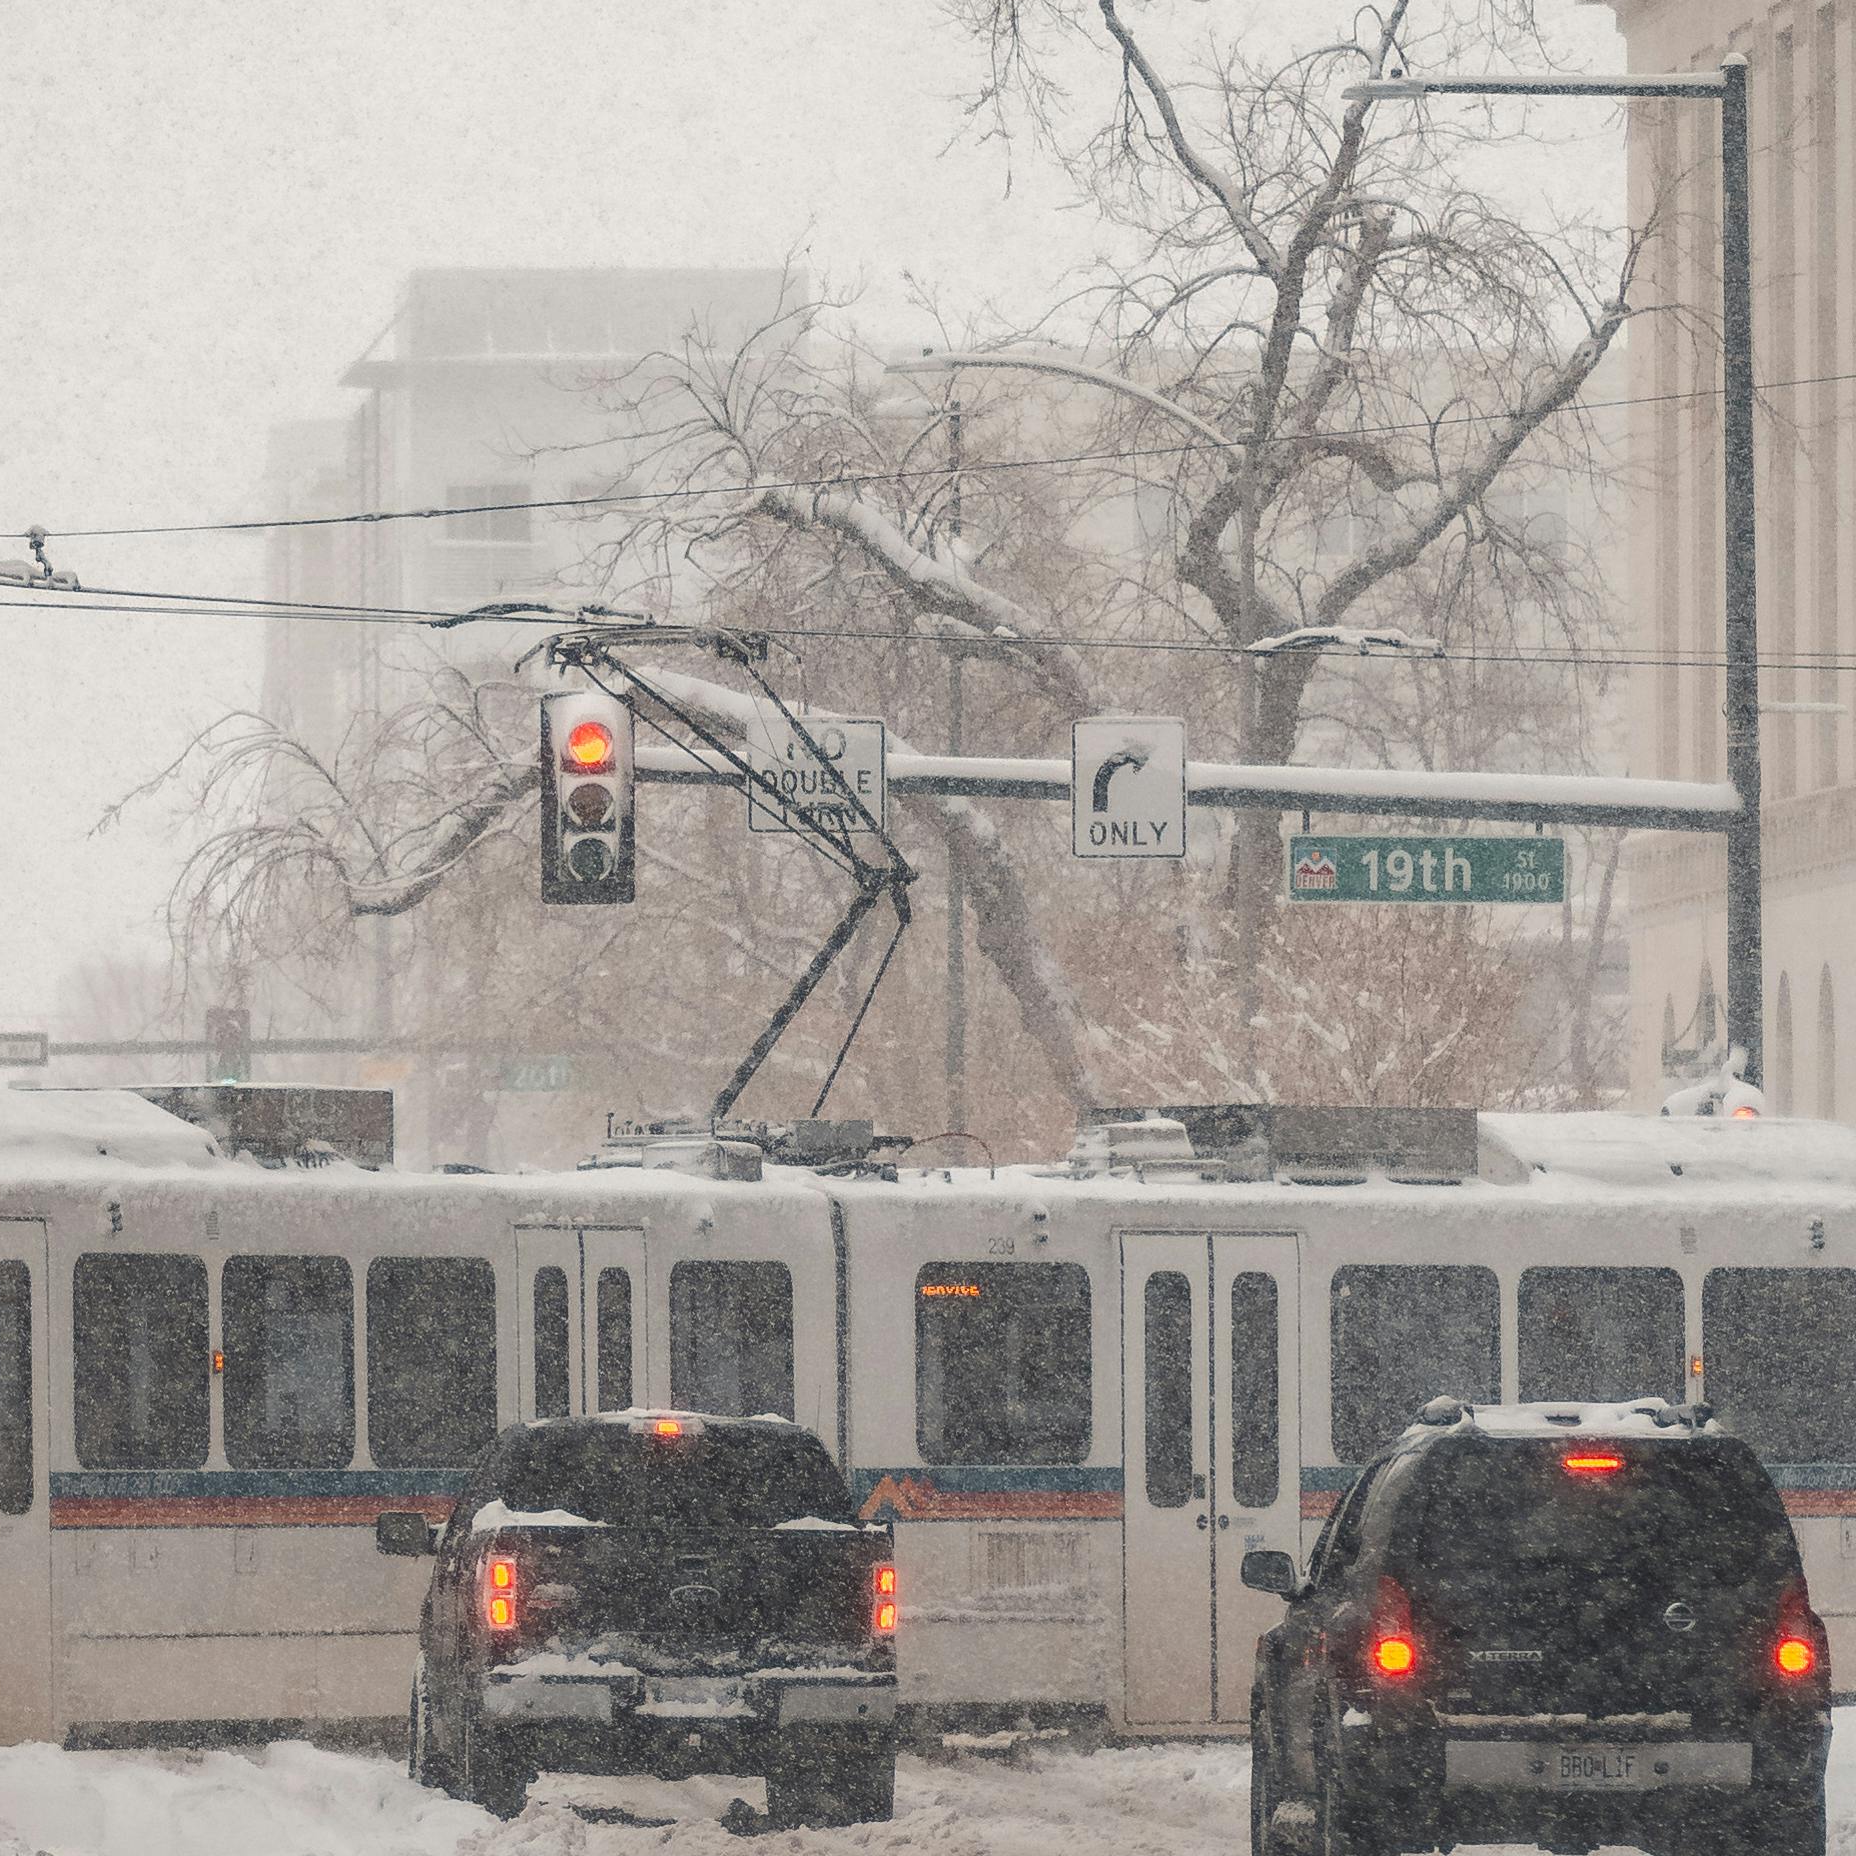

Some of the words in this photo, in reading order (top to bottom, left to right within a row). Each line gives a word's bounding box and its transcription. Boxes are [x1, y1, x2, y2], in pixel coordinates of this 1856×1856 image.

[1089, 820, 1168, 846] ONLY
[1361, 847, 1472, 893] 19th
[1295, 874, 1336, 890] DENVER
[1503, 871, 1551, 891] 1900
[987, 1237, 1016, 1256] 239
[1468, 1649, 1544, 1663] XTERRA
